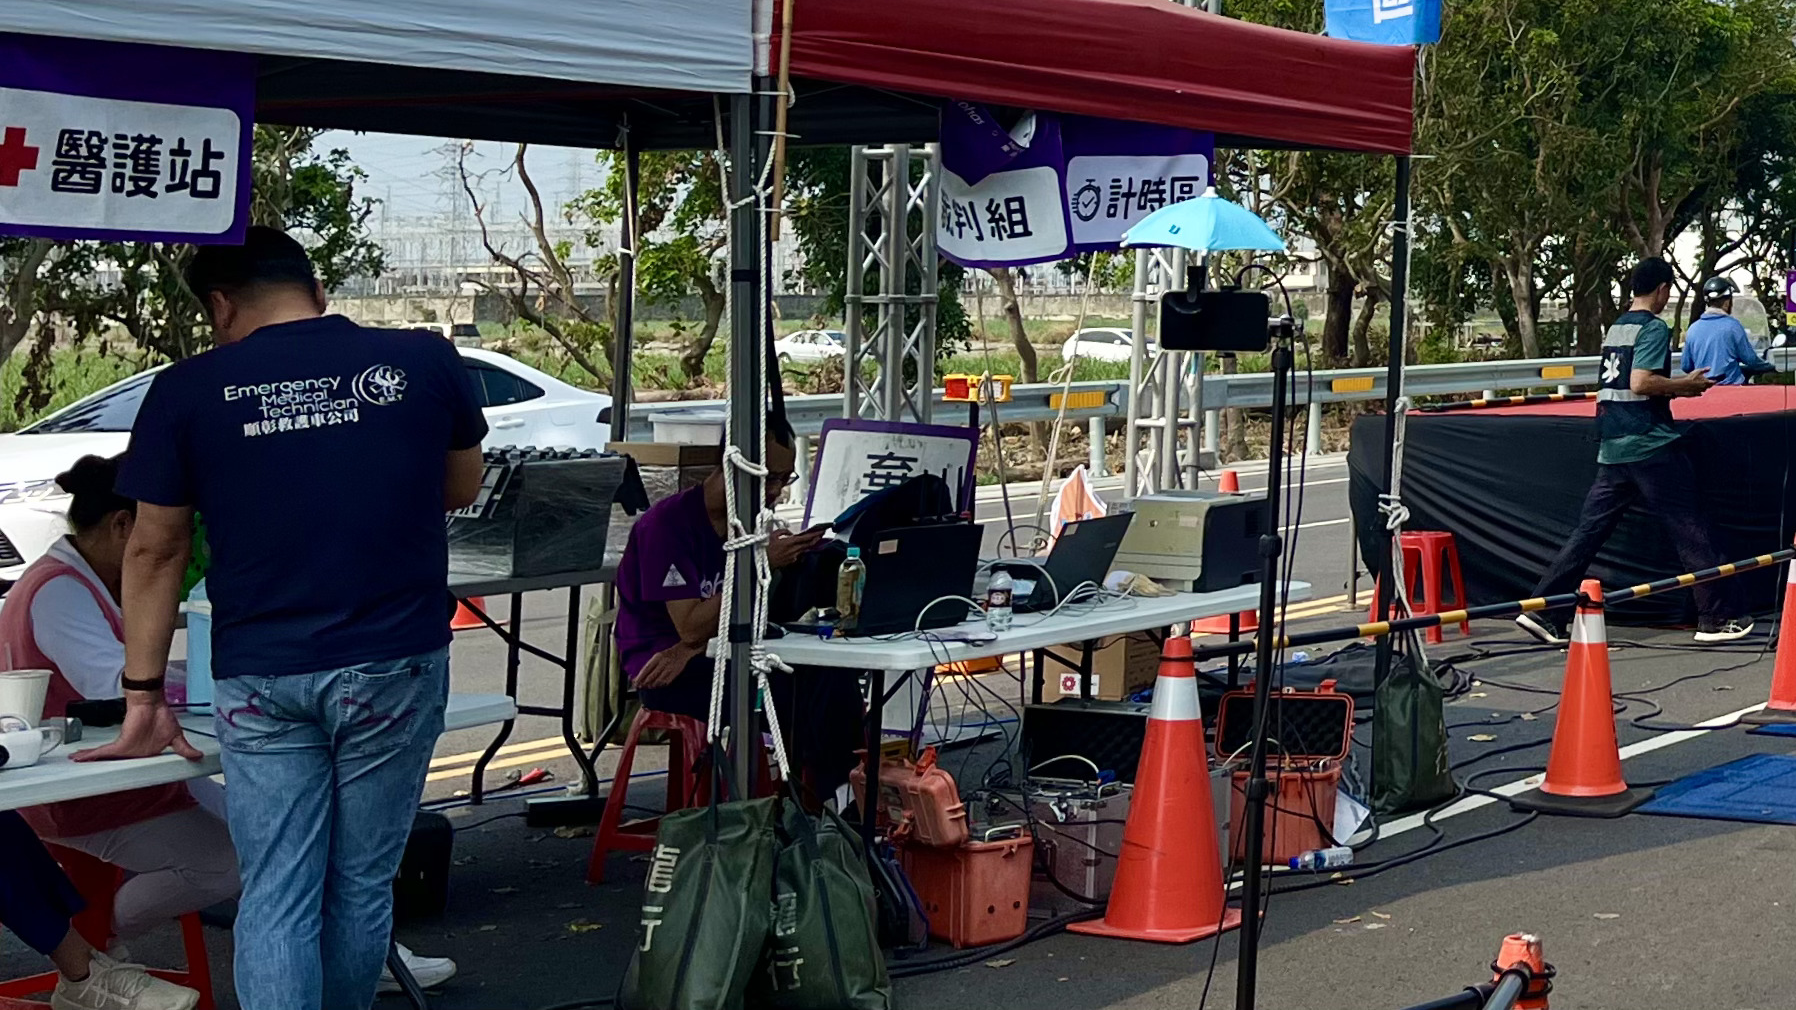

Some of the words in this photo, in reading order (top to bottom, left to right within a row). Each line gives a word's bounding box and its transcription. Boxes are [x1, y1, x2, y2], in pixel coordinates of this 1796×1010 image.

[50, 128, 226, 200] 醫護站
[223, 376, 341, 402] Emergency
[261, 389, 328, 407] Medical
[258, 397, 360, 419] Technician
